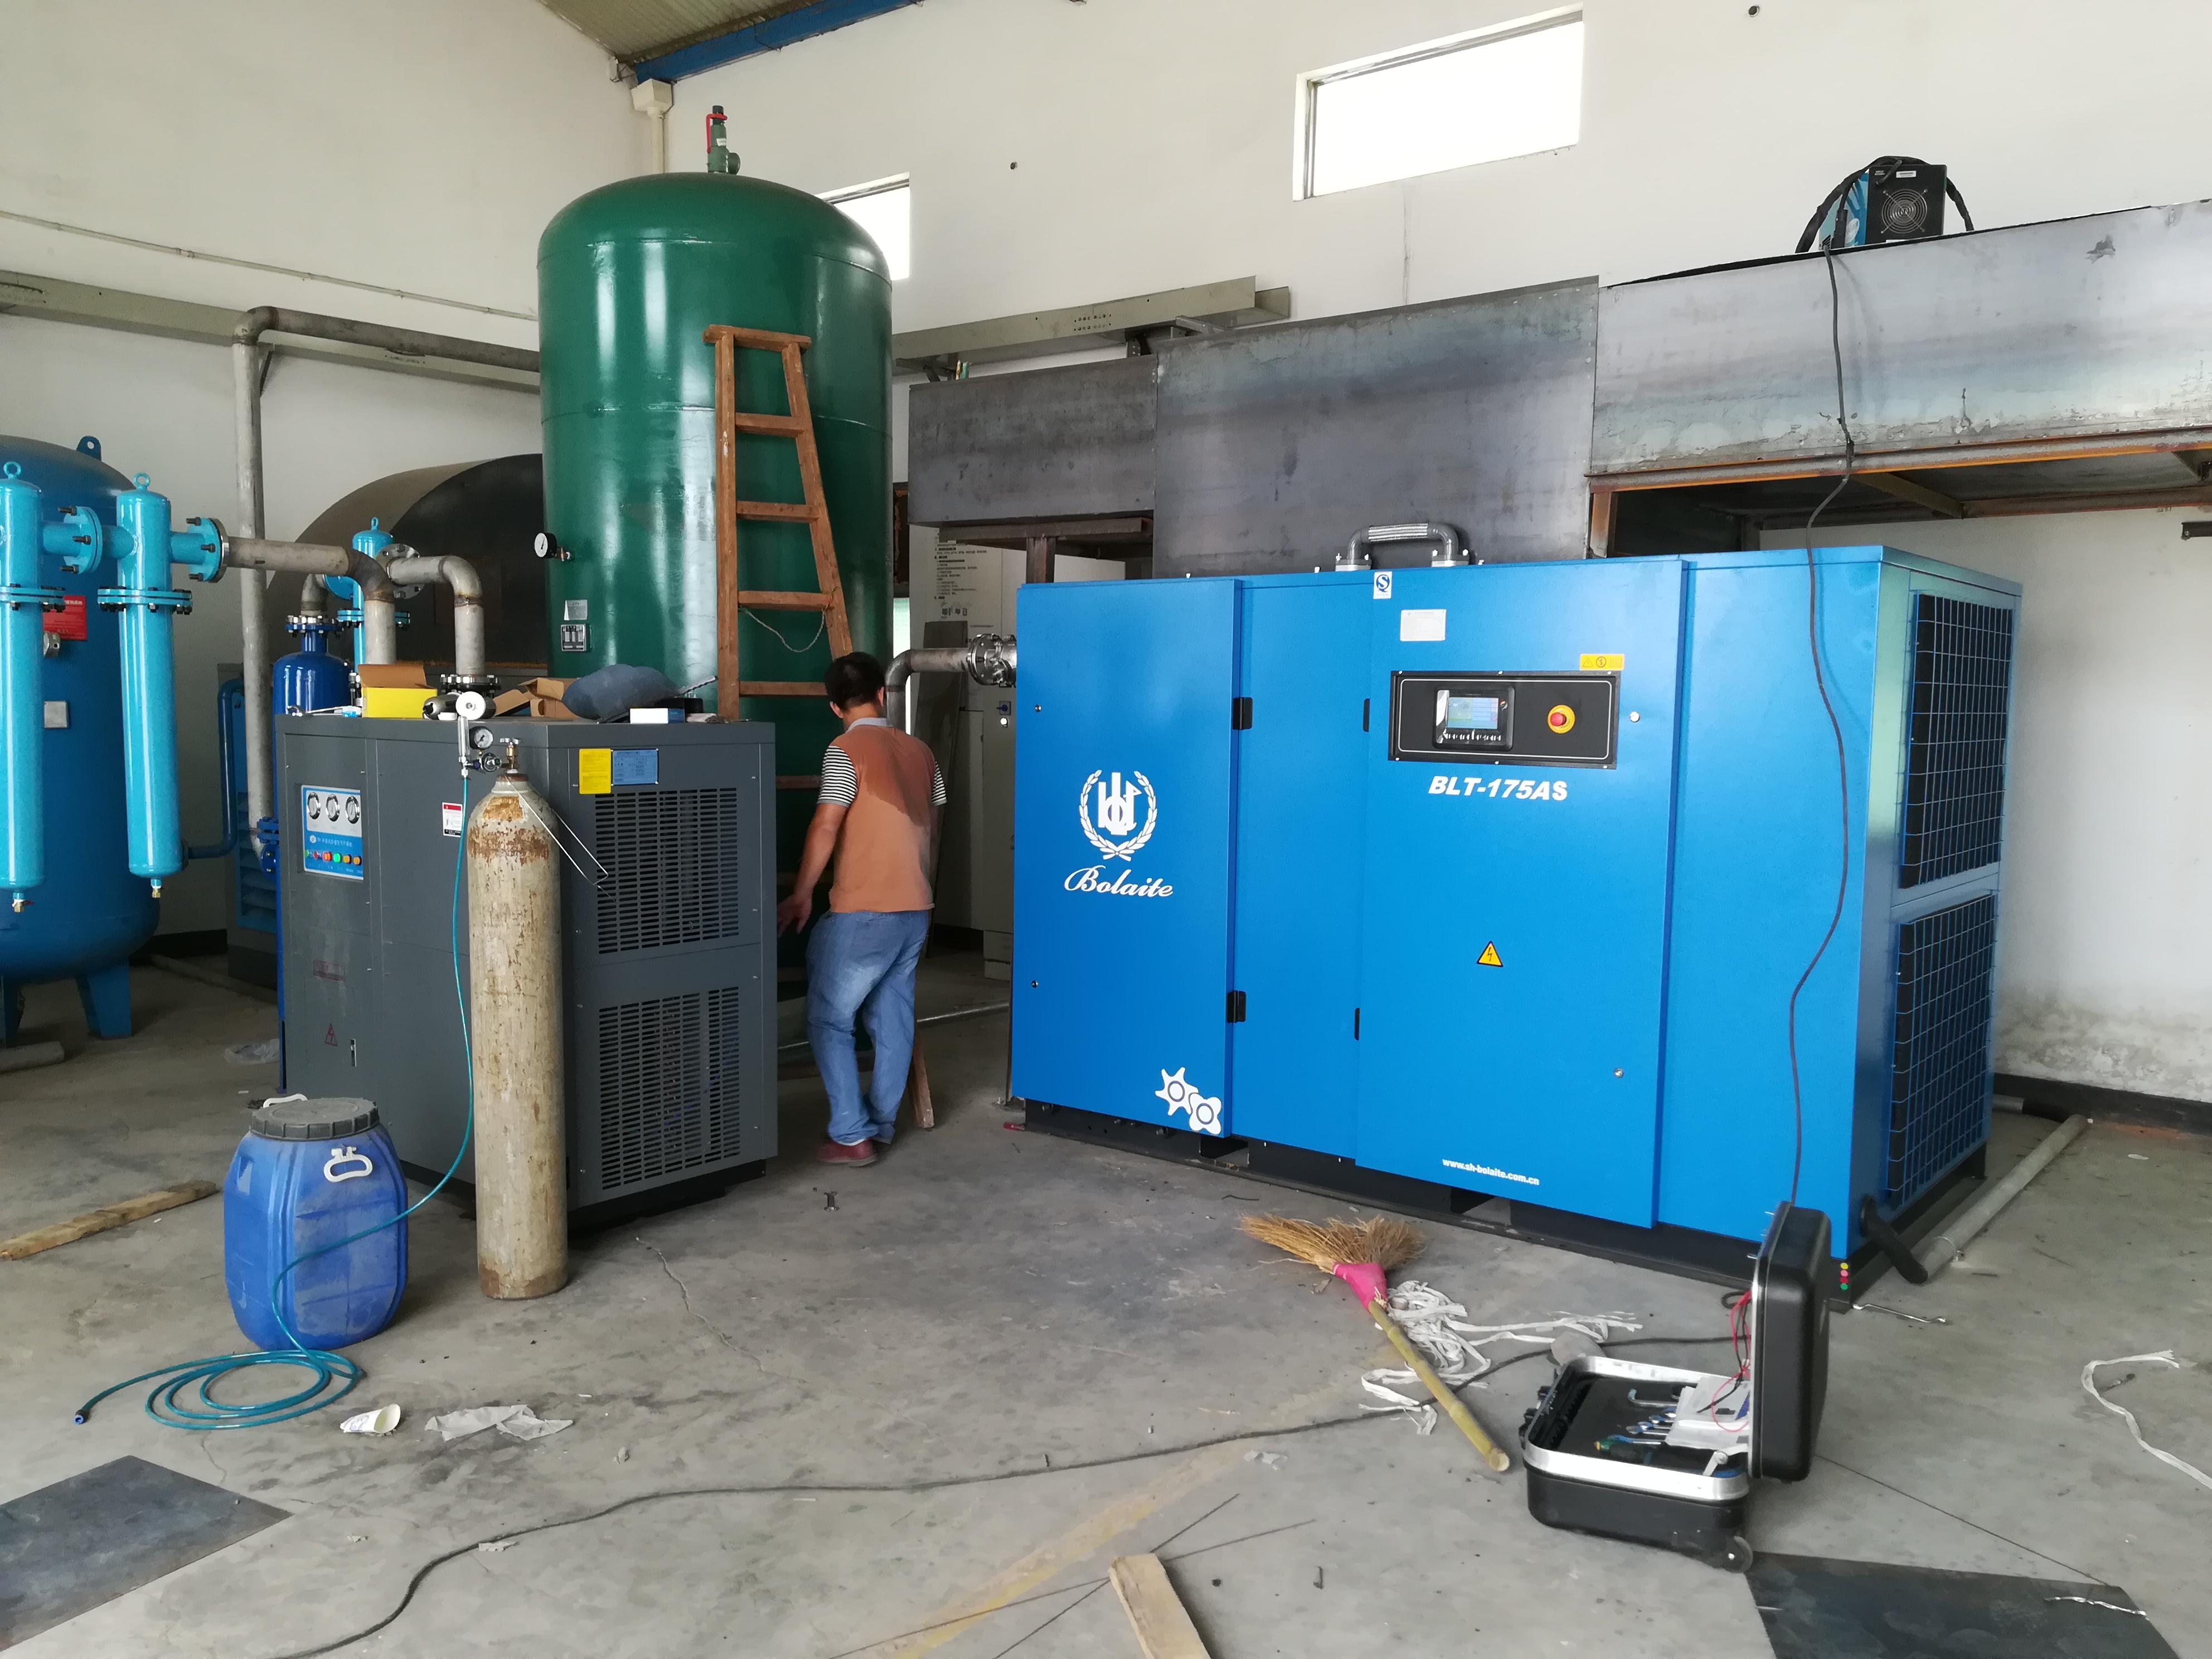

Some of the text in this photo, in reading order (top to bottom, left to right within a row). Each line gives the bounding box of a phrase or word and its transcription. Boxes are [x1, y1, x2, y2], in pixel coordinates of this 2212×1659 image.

[1428, 775, 1568, 801] BLT-175AS
[1064, 865, 1173, 898] Bolaite
[1442, 1158, 1540, 1186] www.sh-bolaite.com.cn
